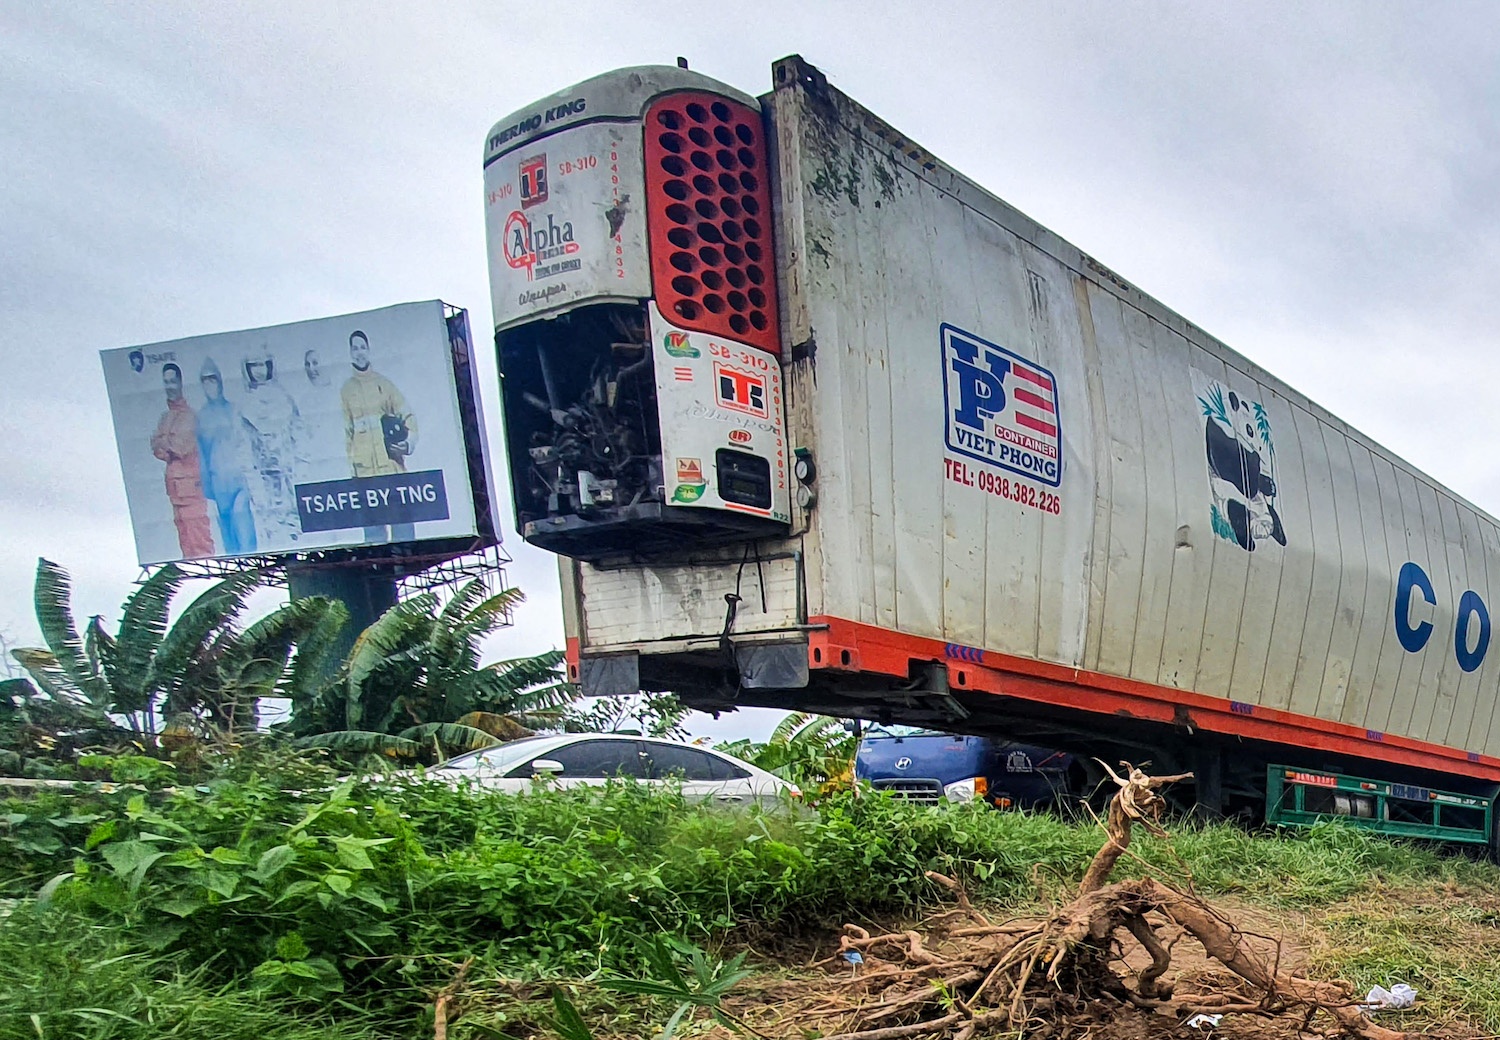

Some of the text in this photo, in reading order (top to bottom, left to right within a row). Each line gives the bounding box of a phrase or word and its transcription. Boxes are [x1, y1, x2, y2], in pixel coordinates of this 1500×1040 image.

[490, 98, 586, 151] THERMO KING
[559, 155, 597, 176] SB-310
[512, 213, 575, 266] Alpha
[709, 342, 769, 371] SB-310
[955, 427, 1057, 478] VIET PHONG
[995, 425, 1056, 458] CONTAINER
[301, 484, 437, 514] TSAFE BY TNG
[944, 458, 1060, 515] TEL: 0938.382.226
[773, 511, 789, 521] R22
